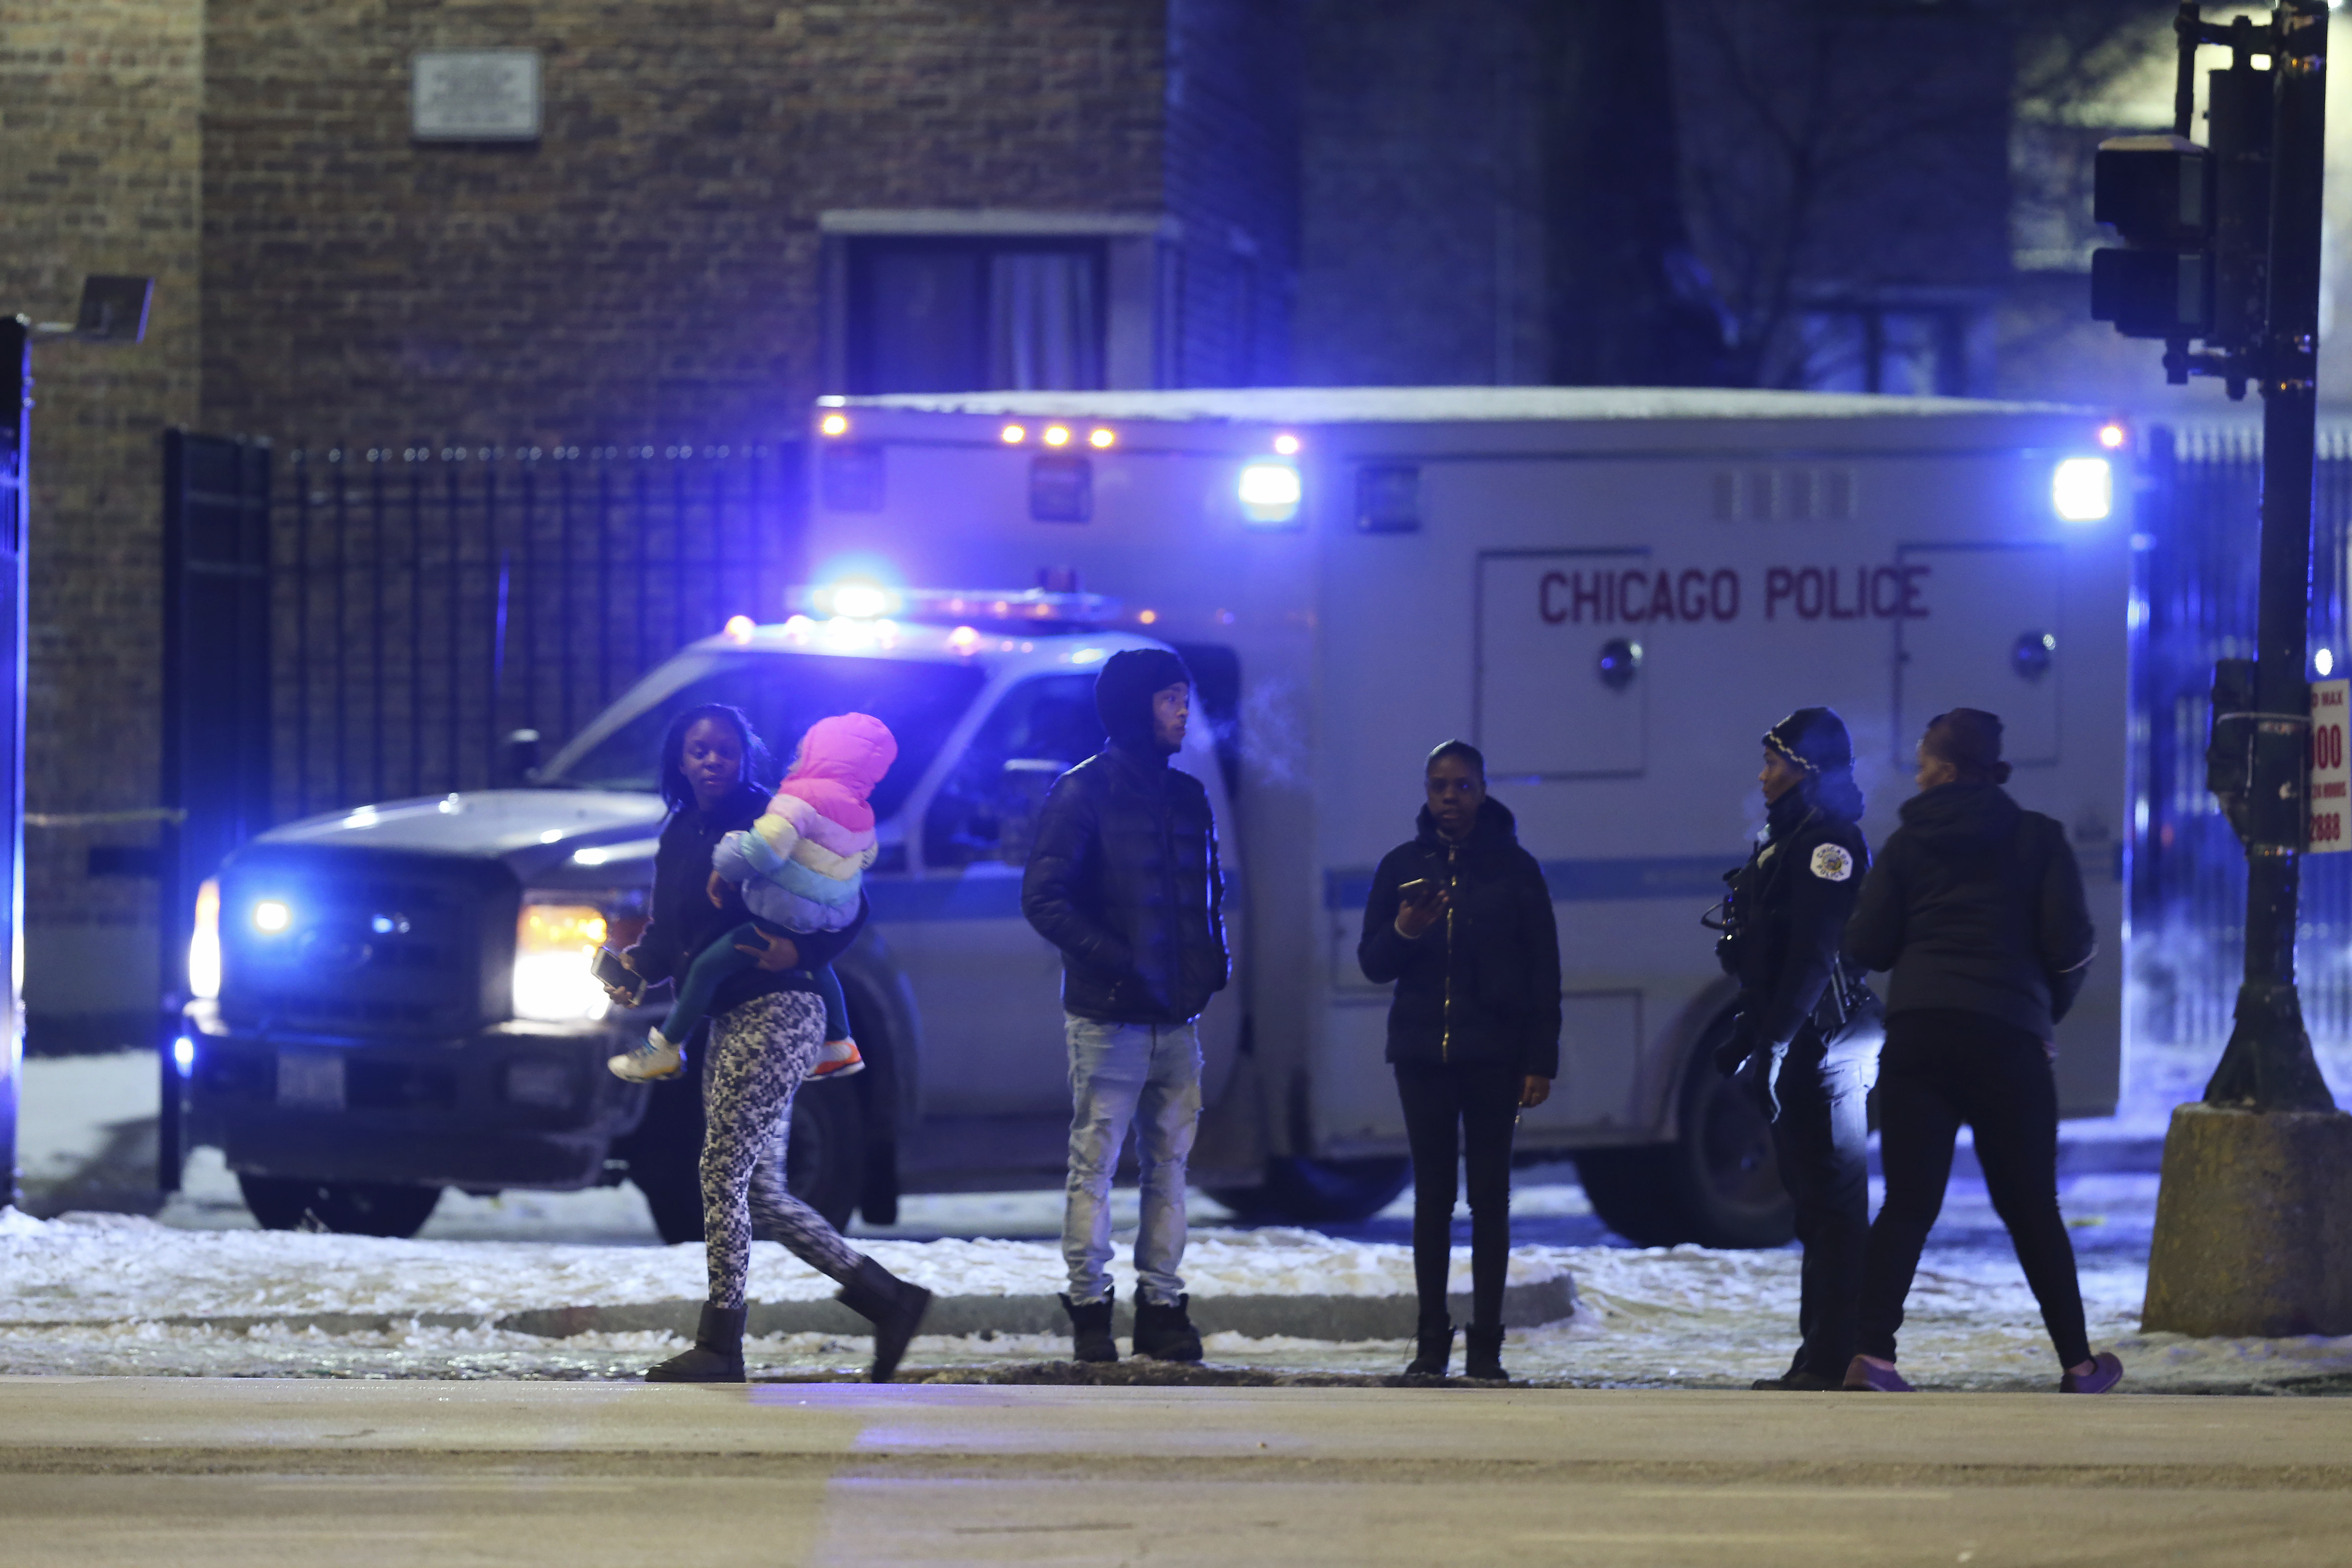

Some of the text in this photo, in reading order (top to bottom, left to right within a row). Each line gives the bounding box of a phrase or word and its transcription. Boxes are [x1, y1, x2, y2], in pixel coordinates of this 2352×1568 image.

[1540, 565, 1931, 624] CHICAGO POLICE
[2310, 724, 2342, 769] 00
[1816, 846, 1849, 865] CHICAGO
[1816, 864, 1844, 878] POLICE
